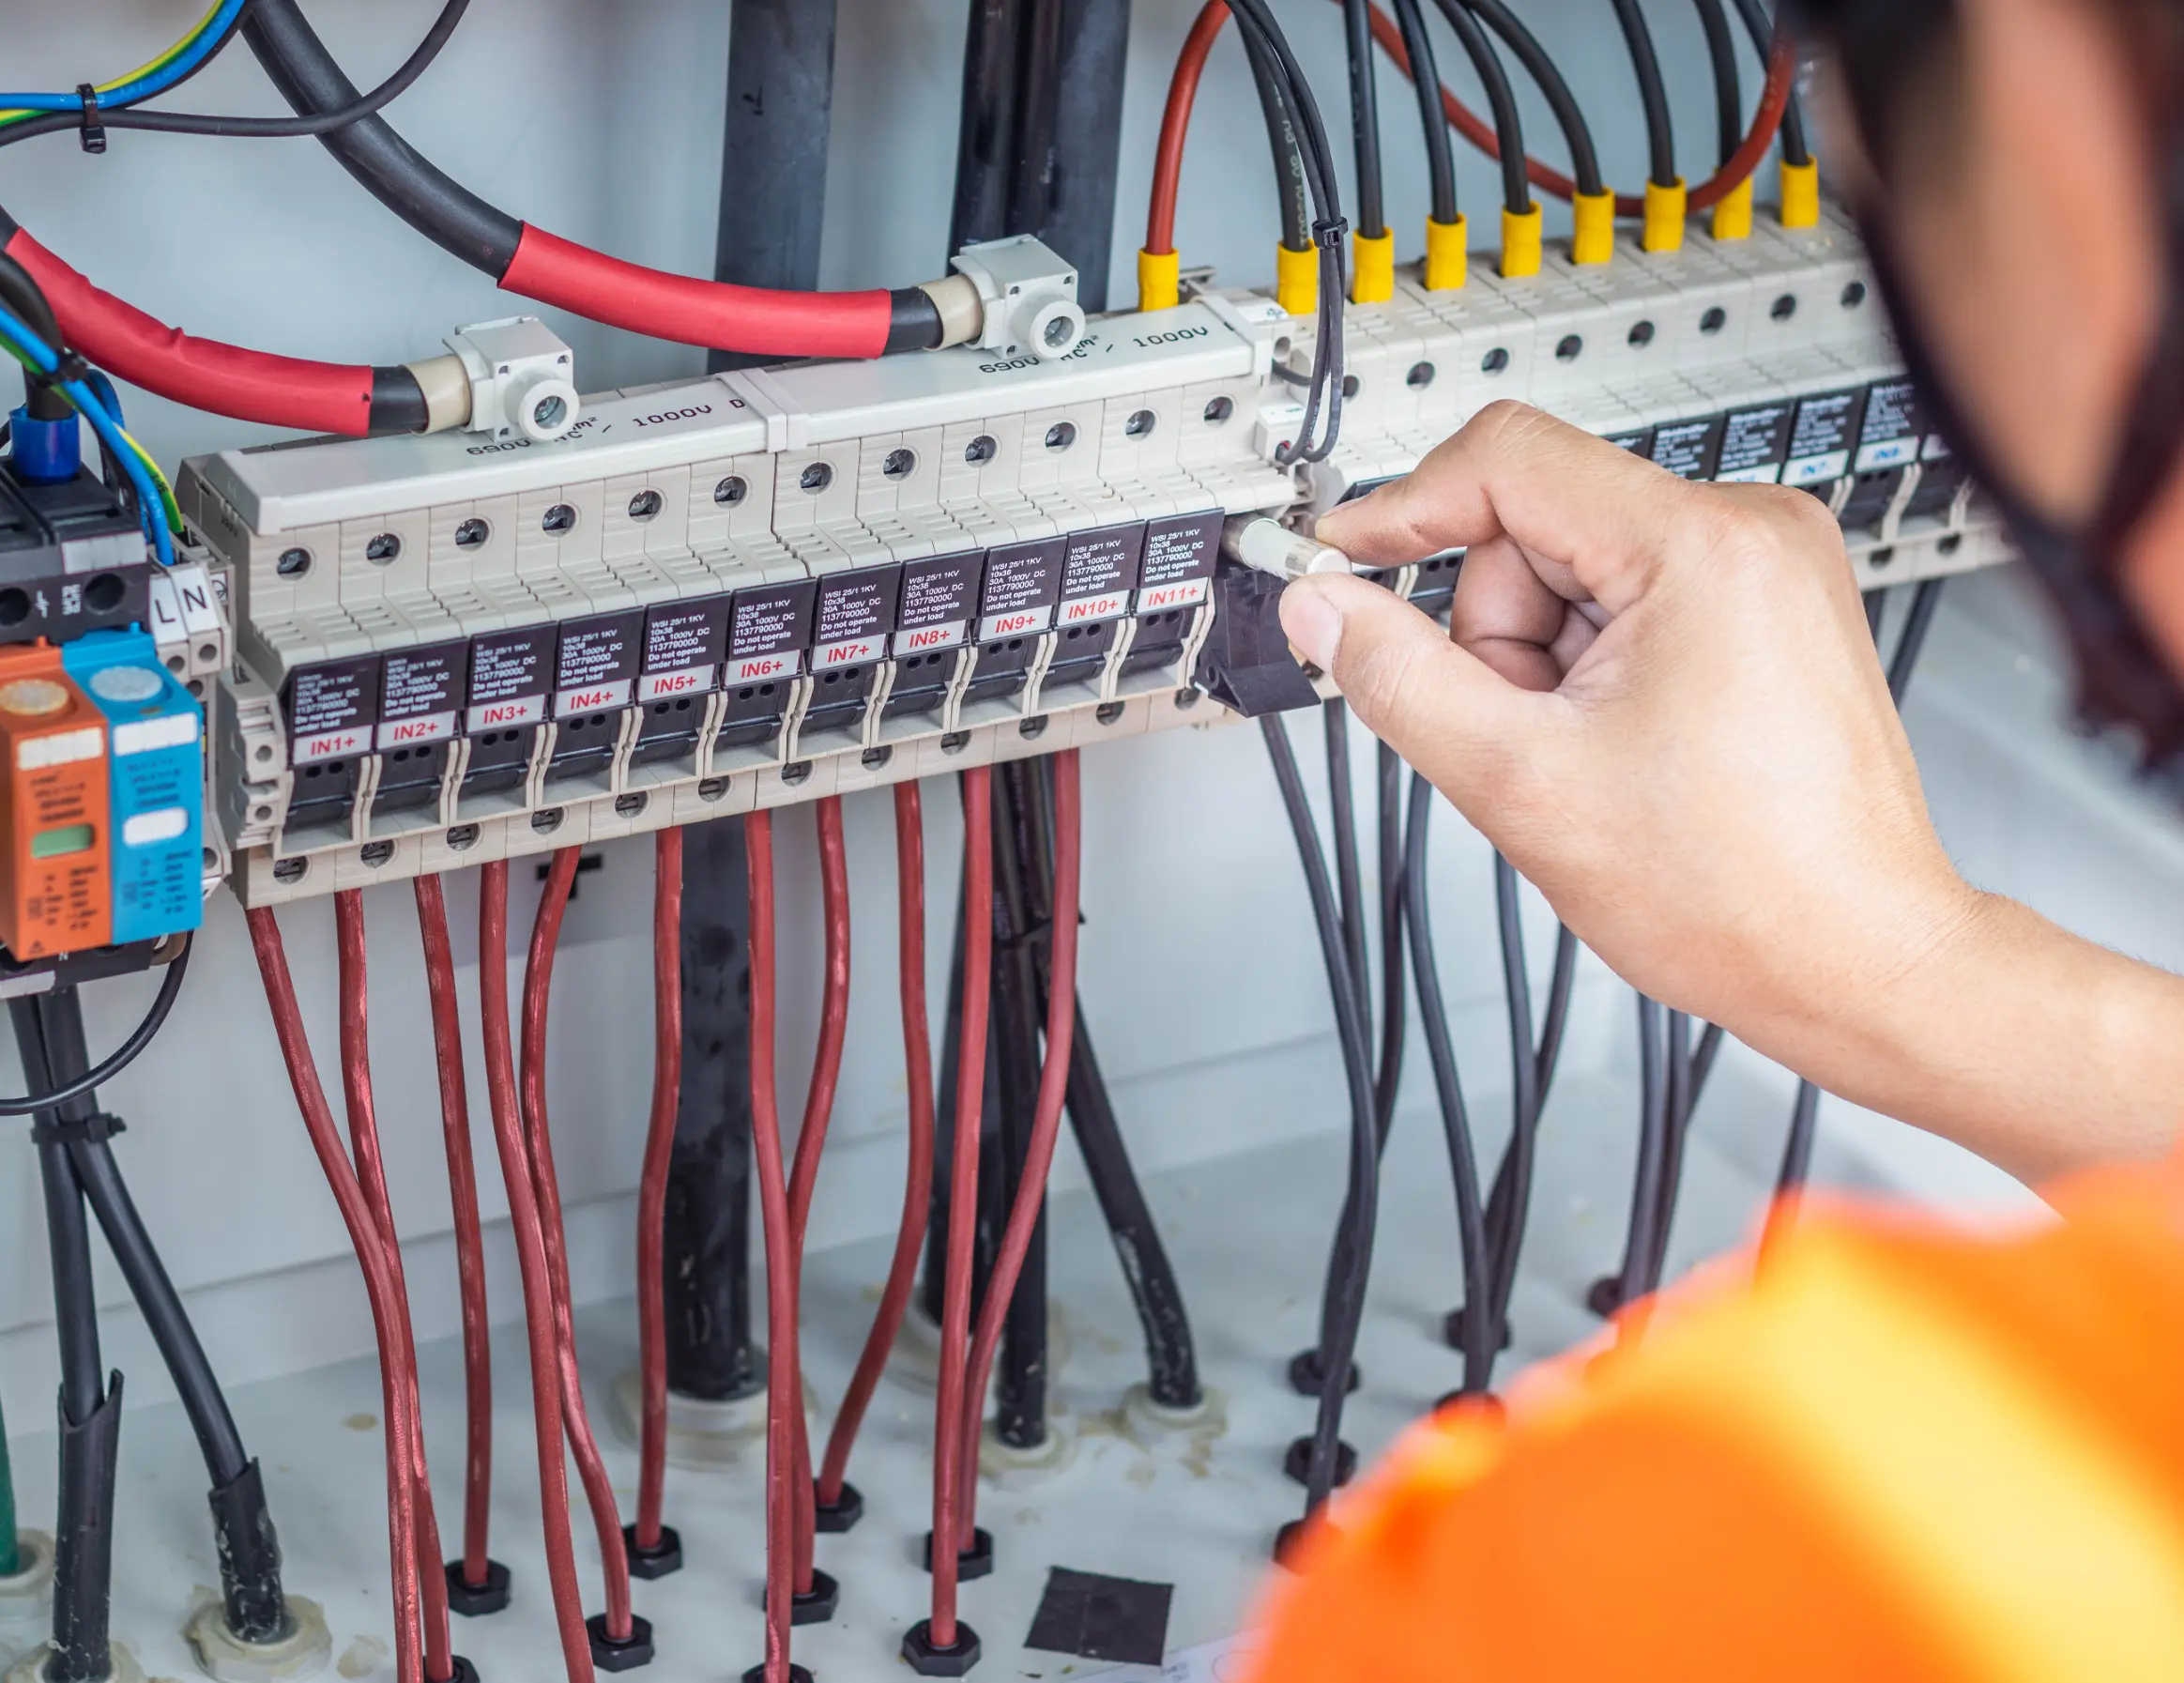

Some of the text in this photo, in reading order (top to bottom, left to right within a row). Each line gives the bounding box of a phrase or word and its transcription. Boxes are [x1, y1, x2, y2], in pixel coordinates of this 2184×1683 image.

[979, 356, 1039, 374] 690V
[1133, 326, 1208, 347] 1000V
[466, 439, 531, 455] 690V
[633, 404, 711, 427] 1000V
[1185, 528, 1200, 537] 1KV
[1107, 540, 1121, 548] 1KV
[1150, 541, 1170, 549] 10x38
[1168, 544, 1189, 554] 1000V
[1027, 557, 1042, 565] 1KV
[1069, 560, 1083, 569] 30A
[1088, 556, 1110, 565] 1000V
[1070, 552, 1092, 561] 10x38
[1171, 559, 1199, 569] operate
[945, 570, 959, 578] 1KV
[989, 570, 1046, 586] 30A 1000V DC
[990, 570, 1011, 578] 10x38
[1092, 572, 1121, 580] operate
[1146, 570, 1184, 582] under load
[862, 585, 877, 593] 1KV
[908, 583, 929, 591] 10x38
[925, 586, 948, 595] 1000V
[952, 583, 964, 591] DC
[1014, 589, 1042, 597] operate
[1066, 582, 1106, 594] under load
[181, 585, 207, 612] N
[824, 597, 846, 606] 10x38
[1148, 588, 1198, 606] IN11+
[775, 600, 790, 608] 1KV
[823, 605, 838, 614] 30A
[843, 601, 865, 610] 1000V
[931, 602, 959, 611] operate
[987, 598, 1027, 611] under load
[154, 599, 176, 623] L
[737, 612, 759, 620] 10x38
[1068, 601, 1119, 620] IN10+
[652, 620, 668, 629] WSI
[690, 614, 705, 623] 1KV
[756, 615, 779, 625] 1000V
[848, 616, 878, 625] operate
[904, 612, 944, 625] under load
[996, 616, 1036, 634] IN9+
[650, 635, 665, 644] 30A
[670, 630, 694, 640] 1000V
[651, 627, 673, 636] 10x38
[762, 632, 791, 641] operate
[821, 626, 862, 639] under load
[909, 631, 950, 649] IN8+
[677, 647, 706, 656] operate
[734, 642, 775, 654] under load
[827, 645, 870, 664] IN7+
[589, 662, 619, 671] operate
[649, 657, 690, 670] under load
[741, 661, 783, 679] IN6+
[561, 672, 603, 686] under load
[654, 677, 696, 695] IN5+
[570, 693, 613, 711] IN4+
[483, 707, 527, 724] IN3+
[394, 724, 437, 740] IN2+
[312, 738, 355, 755] IN1+
